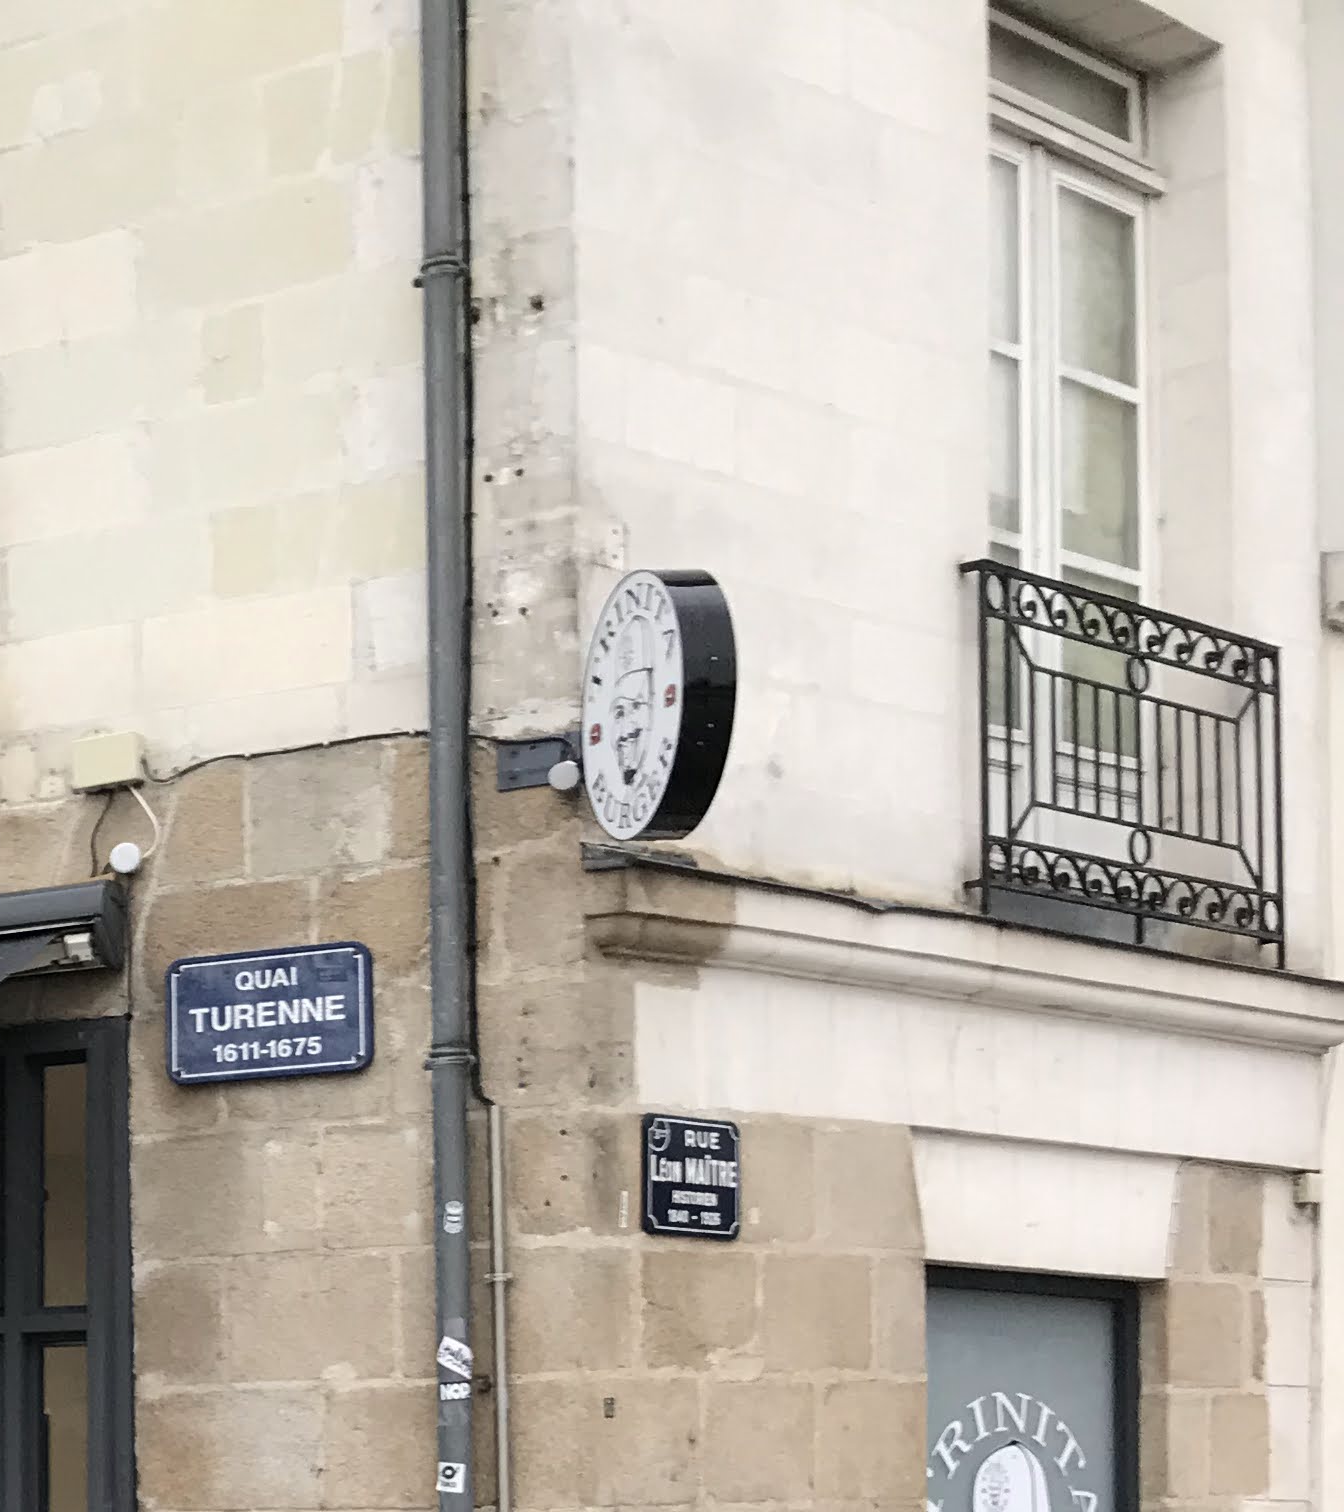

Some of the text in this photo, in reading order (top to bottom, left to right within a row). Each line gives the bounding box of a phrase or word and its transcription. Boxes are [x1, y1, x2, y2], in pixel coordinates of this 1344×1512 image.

[235, 966, 299, 991] QUAI
[189, 994, 346, 1033] TURENNE
[212, 1036, 323, 1063] 1611-1675
[684, 1129, 721, 1150] RUE
[684, 1154, 738, 1187] MAÎTRE
